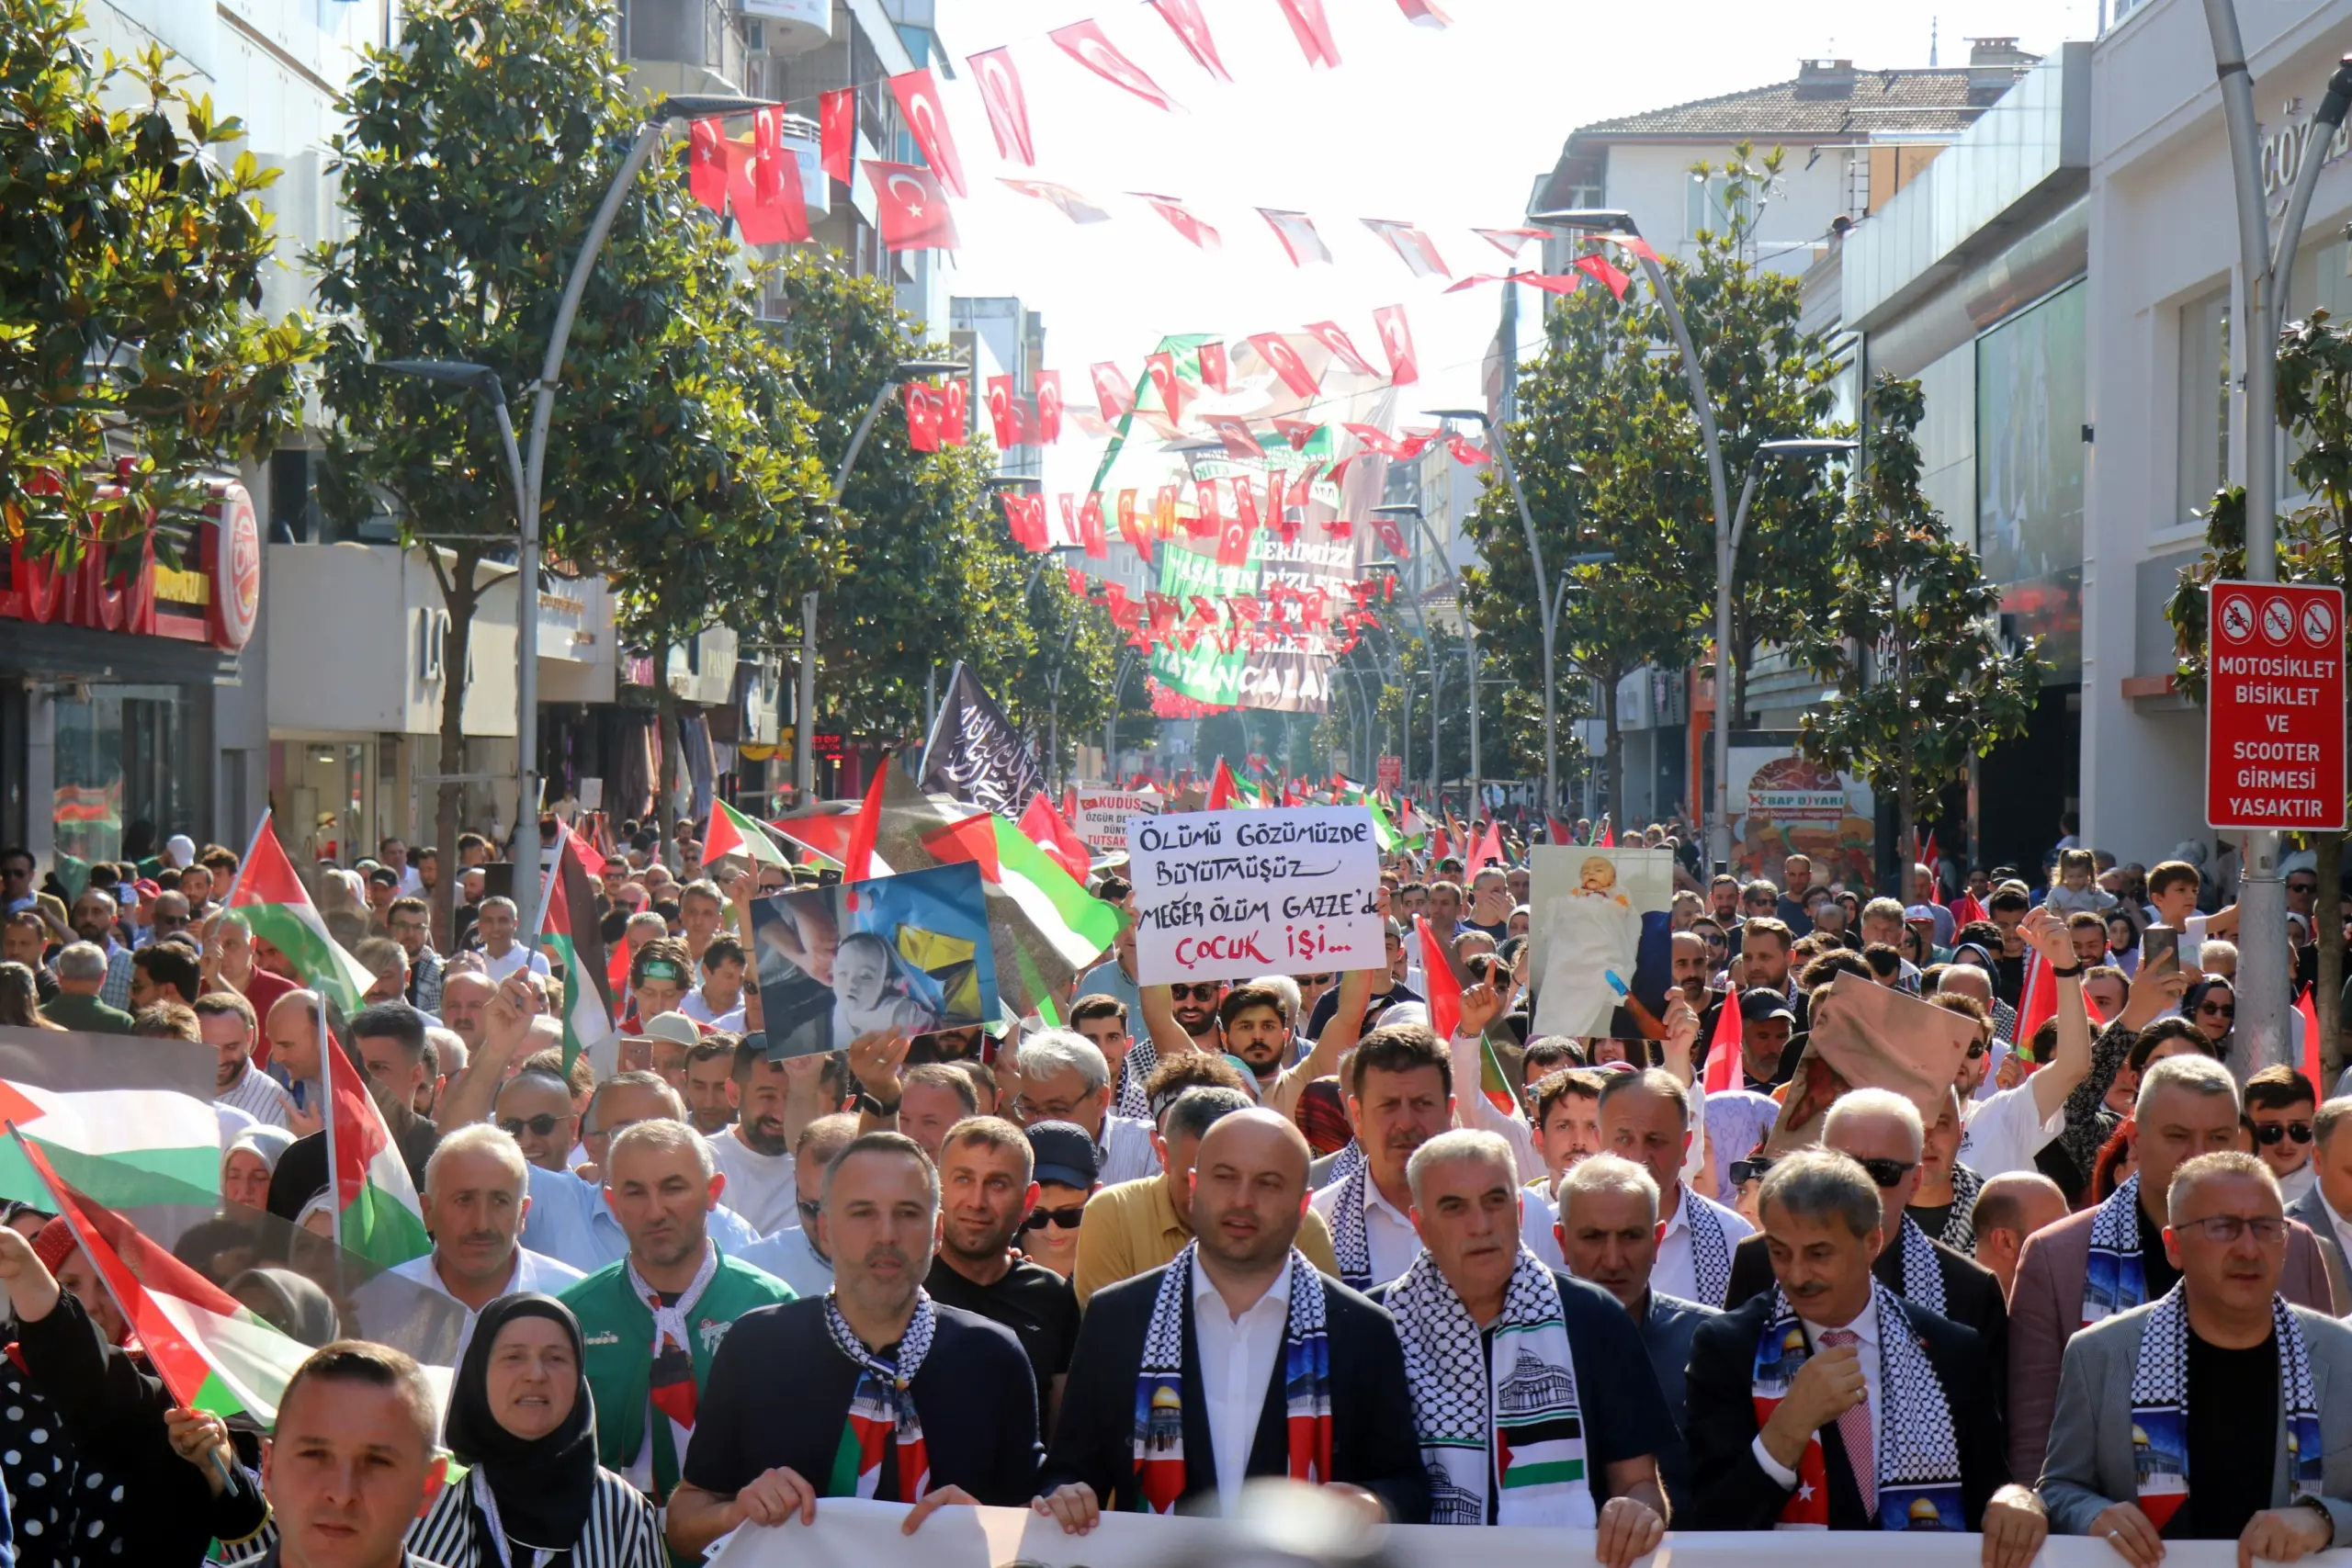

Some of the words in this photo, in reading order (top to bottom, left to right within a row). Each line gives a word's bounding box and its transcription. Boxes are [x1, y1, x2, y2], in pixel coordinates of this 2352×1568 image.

[2219, 654, 2336, 679] MOTOSİKLET
[2235, 682, 2320, 706] BİSİKLET
[2266, 714, 2290, 733] VE
[2233, 741, 2321, 761] SCOOTER
[2237, 765, 2316, 790] GİRMESİ
[1098, 795, 1142, 810] KUDÜS
[2229, 797, 2323, 818] YASAKTIR
[1085, 812, 1114, 823] ÖZGÜR
[1088, 835, 1127, 847] TUTSAK
[1103, 825, 1128, 835] DÜNY
[1139, 820, 1222, 852] ÖLÜMÜ
[1157, 855, 1341, 886] BÜYÜTMÜŞÜZ
[1137, 891, 1204, 931] MEĞER
[1210, 896, 1271, 923] ÖLÜM
[1175, 930, 1275, 970] ÇOCUK
